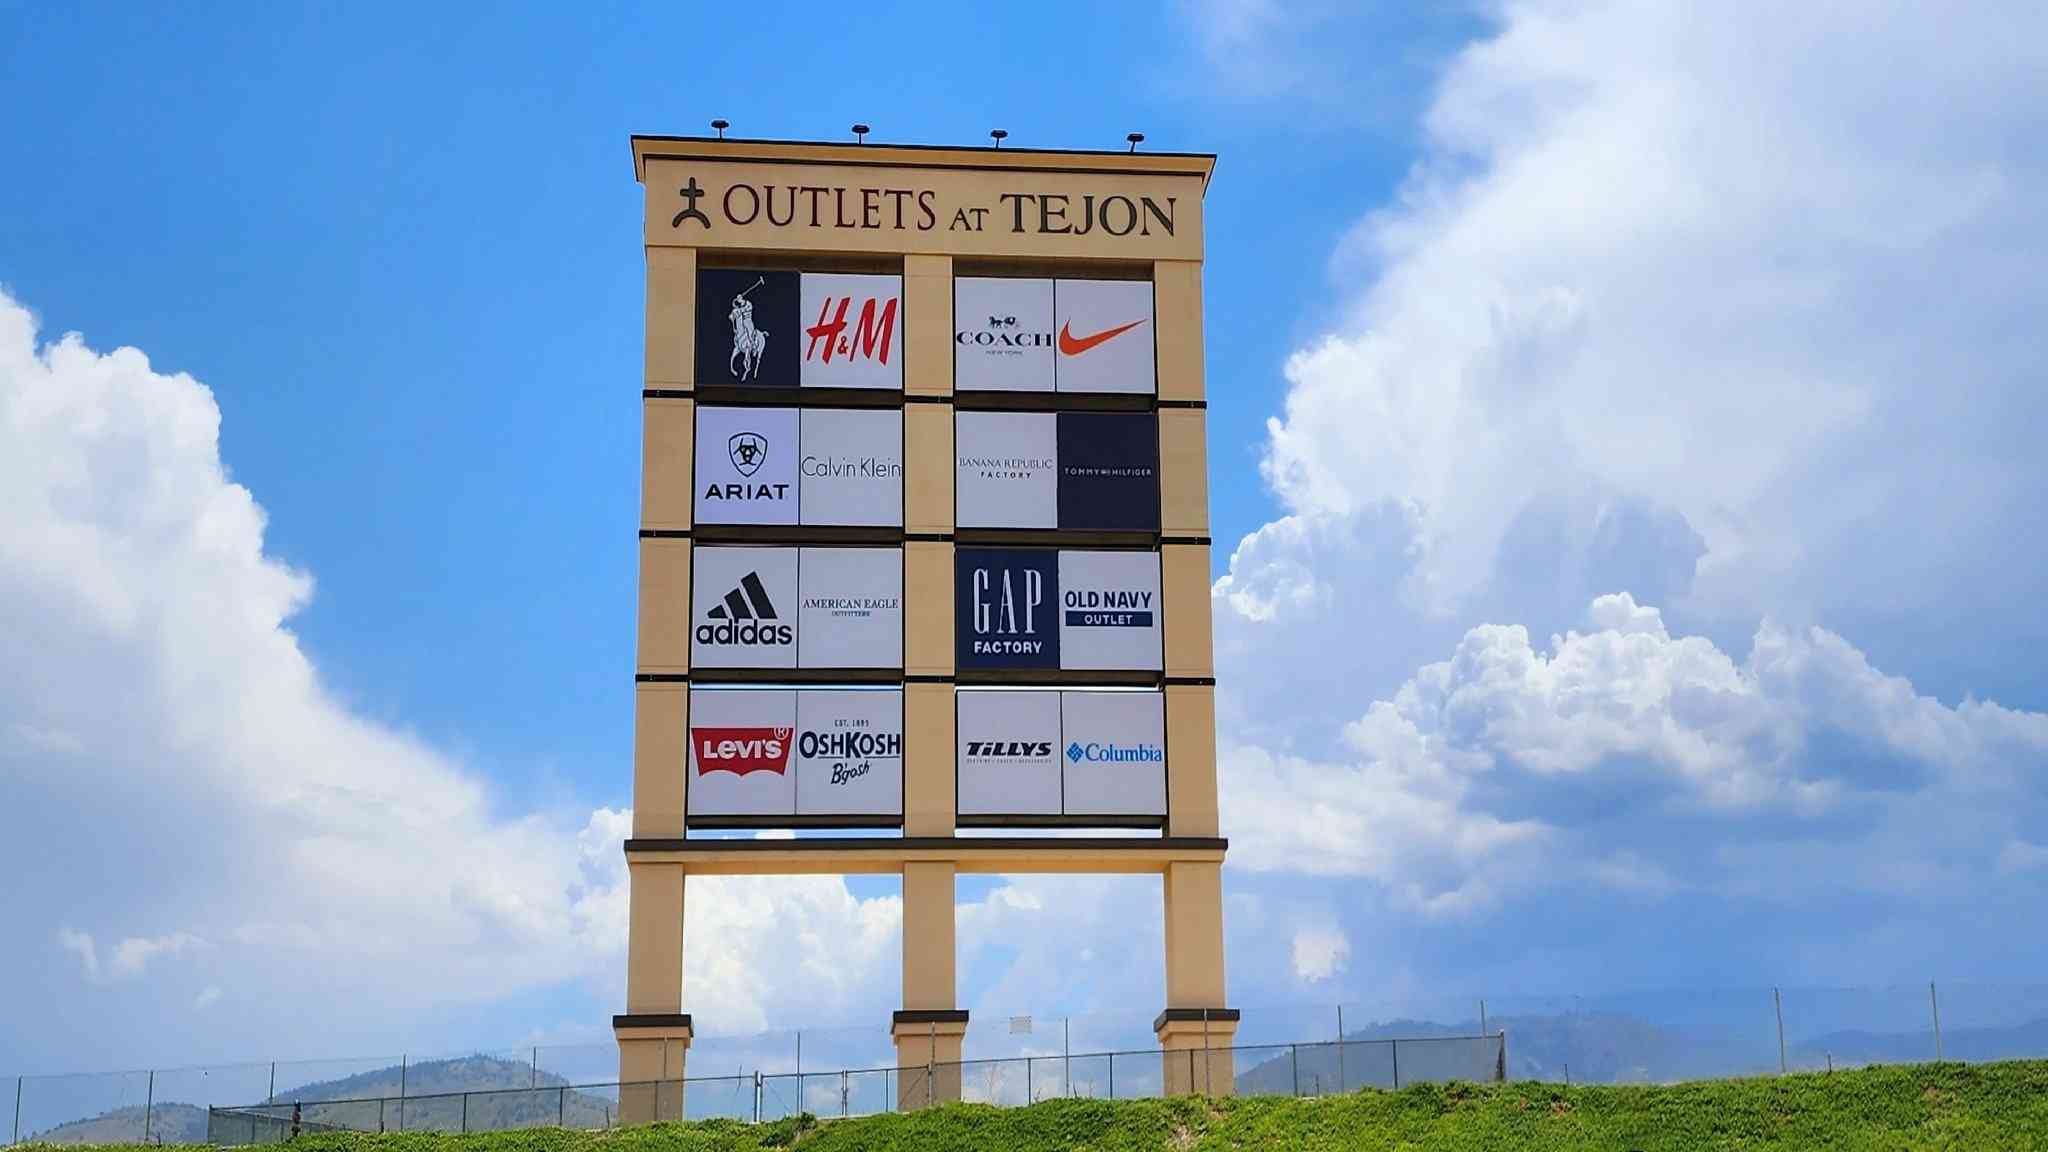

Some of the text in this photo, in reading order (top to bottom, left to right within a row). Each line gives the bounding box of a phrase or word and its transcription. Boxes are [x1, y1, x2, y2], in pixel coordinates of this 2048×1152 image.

[723, 184, 1177, 237] OUTLETS AT TEJON
[806, 296, 898, 366] H&M
[957, 331, 1052, 347] COACH
[801, 456, 901, 478] Calvin Klein
[959, 456, 1053, 470] BANANA REPUBLIC
[980, 471, 1032, 479] FACTORY
[1064, 467, 1153, 477] TOMMY HILFIGER
[705, 484, 790, 500] ARIAT
[803, 598, 899, 609] AMERICAN EAGLE
[973, 568, 1043, 635] GAP
[1065, 590, 1152, 609] OLD NAVY
[1084, 614, 1134, 625] OUTLET
[696, 618, 793, 646] adidas
[974, 641, 1042, 655] FACTORY
[799, 731, 900, 759] OSHKOSH
[1085, 743, 1162, 762] Columbia
